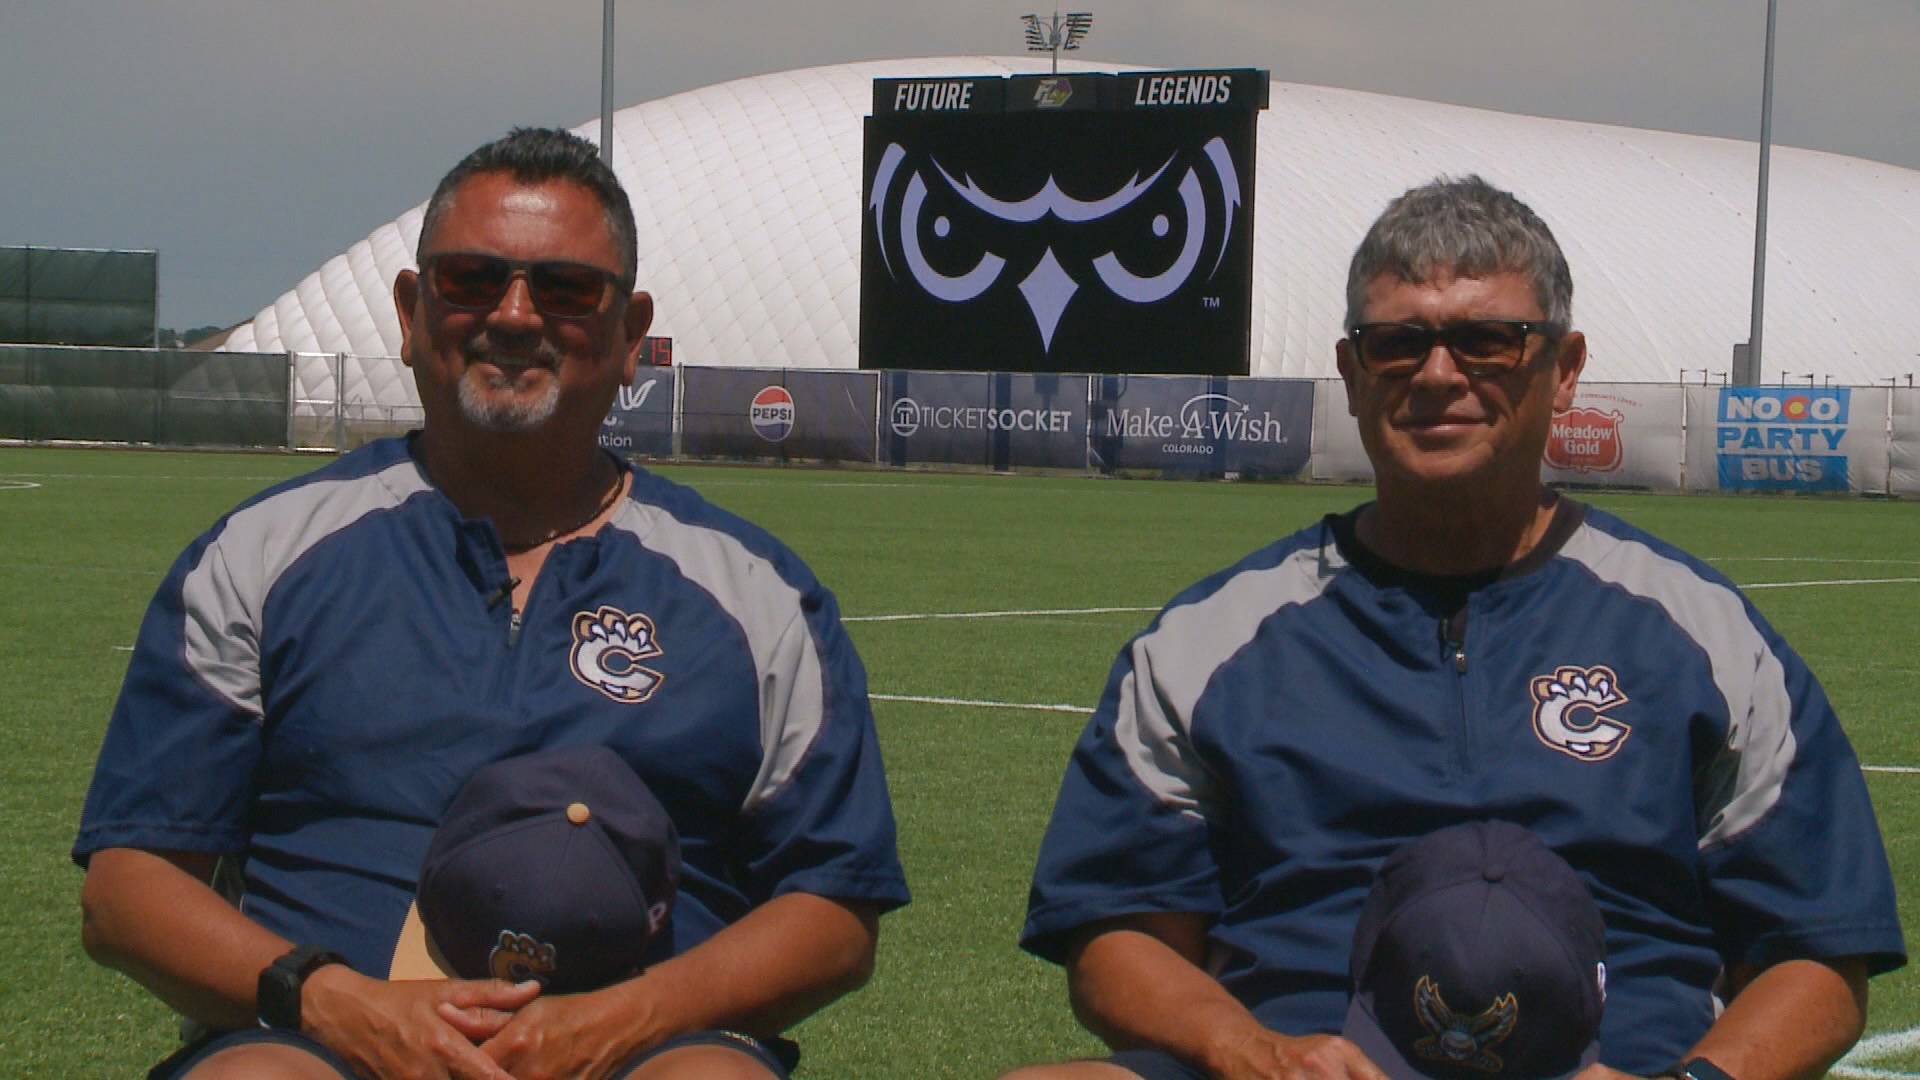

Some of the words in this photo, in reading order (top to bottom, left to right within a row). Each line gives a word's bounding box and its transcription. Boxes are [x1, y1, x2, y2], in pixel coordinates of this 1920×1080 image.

[894, 82, 974, 111] FUTURE
[1135, 75, 1231, 105] LEGENDS
[1203, 297, 1220, 308] TM
[651, 337, 671, 365] 15
[752, 407, 792, 421] PEPSI
[921, 406, 1071, 433] TICKETSOCKET
[1727, 396, 1840, 421] NOCO
[1552, 424, 1612, 440] Meadow
[1717, 427, 1846, 450] PARTY
[1162, 443, 1213, 455] COLORADO
[1565, 440, 1600, 455] Gold
[1743, 457, 1822, 482] BUS
[569, 605, 665, 705] C
[1529, 664, 1631, 762] C
